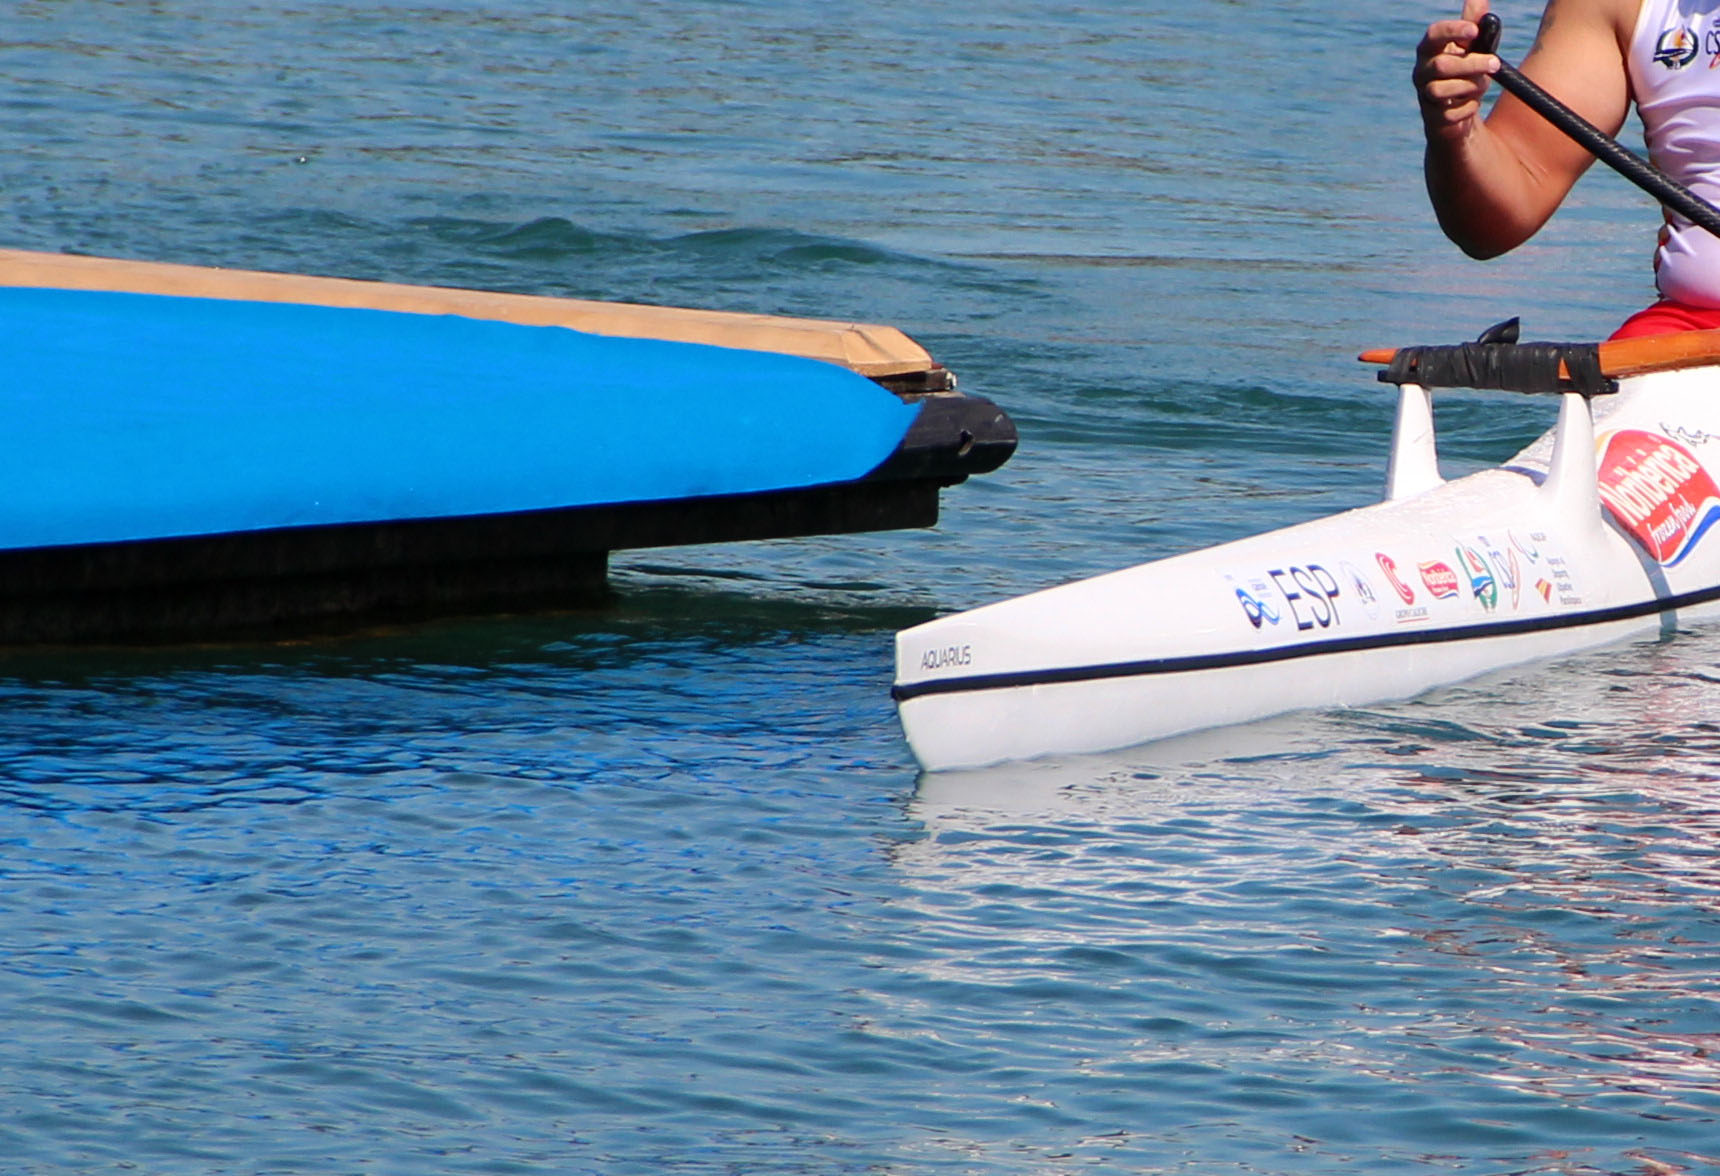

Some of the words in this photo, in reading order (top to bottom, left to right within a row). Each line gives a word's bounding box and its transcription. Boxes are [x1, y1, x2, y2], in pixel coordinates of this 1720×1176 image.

[1647, 514, 1682, 563] frozen
[1267, 564, 1341, 631] ESP
[921, 645, 972, 670] AQUARIUS
